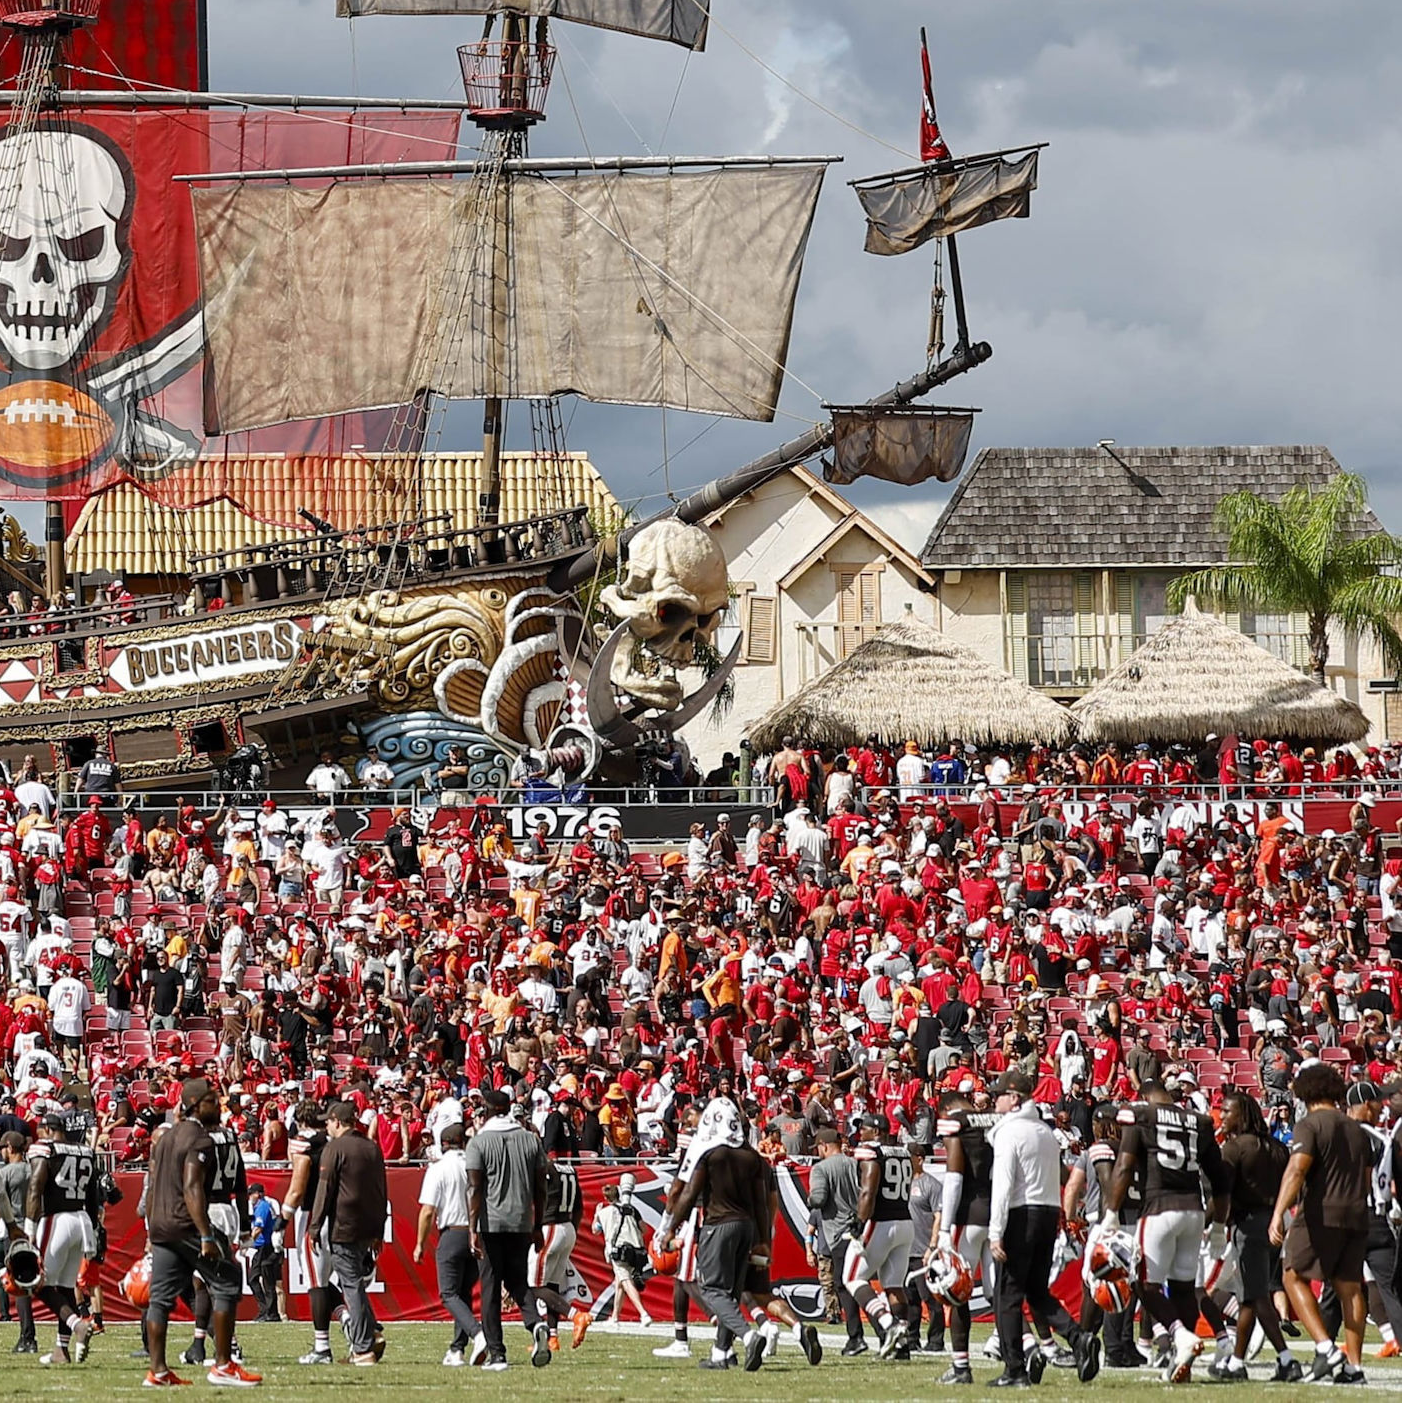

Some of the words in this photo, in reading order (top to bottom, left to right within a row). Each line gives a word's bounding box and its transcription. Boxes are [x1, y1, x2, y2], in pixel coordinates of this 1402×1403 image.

[125, 620, 298, 687] BUCCANEERS
[1142, 773, 1152, 785] 6
[506, 805, 622, 838] 1976
[91, 826, 100, 839] 6
[769, 899, 781, 914] 6
[928, 920, 935, 937] 3
[469, 940, 478, 957] 6
[990, 937, 999, 953] 6
[64, 992, 72, 1007] 3
[1136, 1007, 1146, 1019] 0
[1157, 1108, 1182, 1127] HALL
[1157, 1124, 1199, 1172] 51
[55, 1155, 93, 1201] 42
[881, 1157, 913, 1202] 98
[558, 1173, 576, 1213] 11
